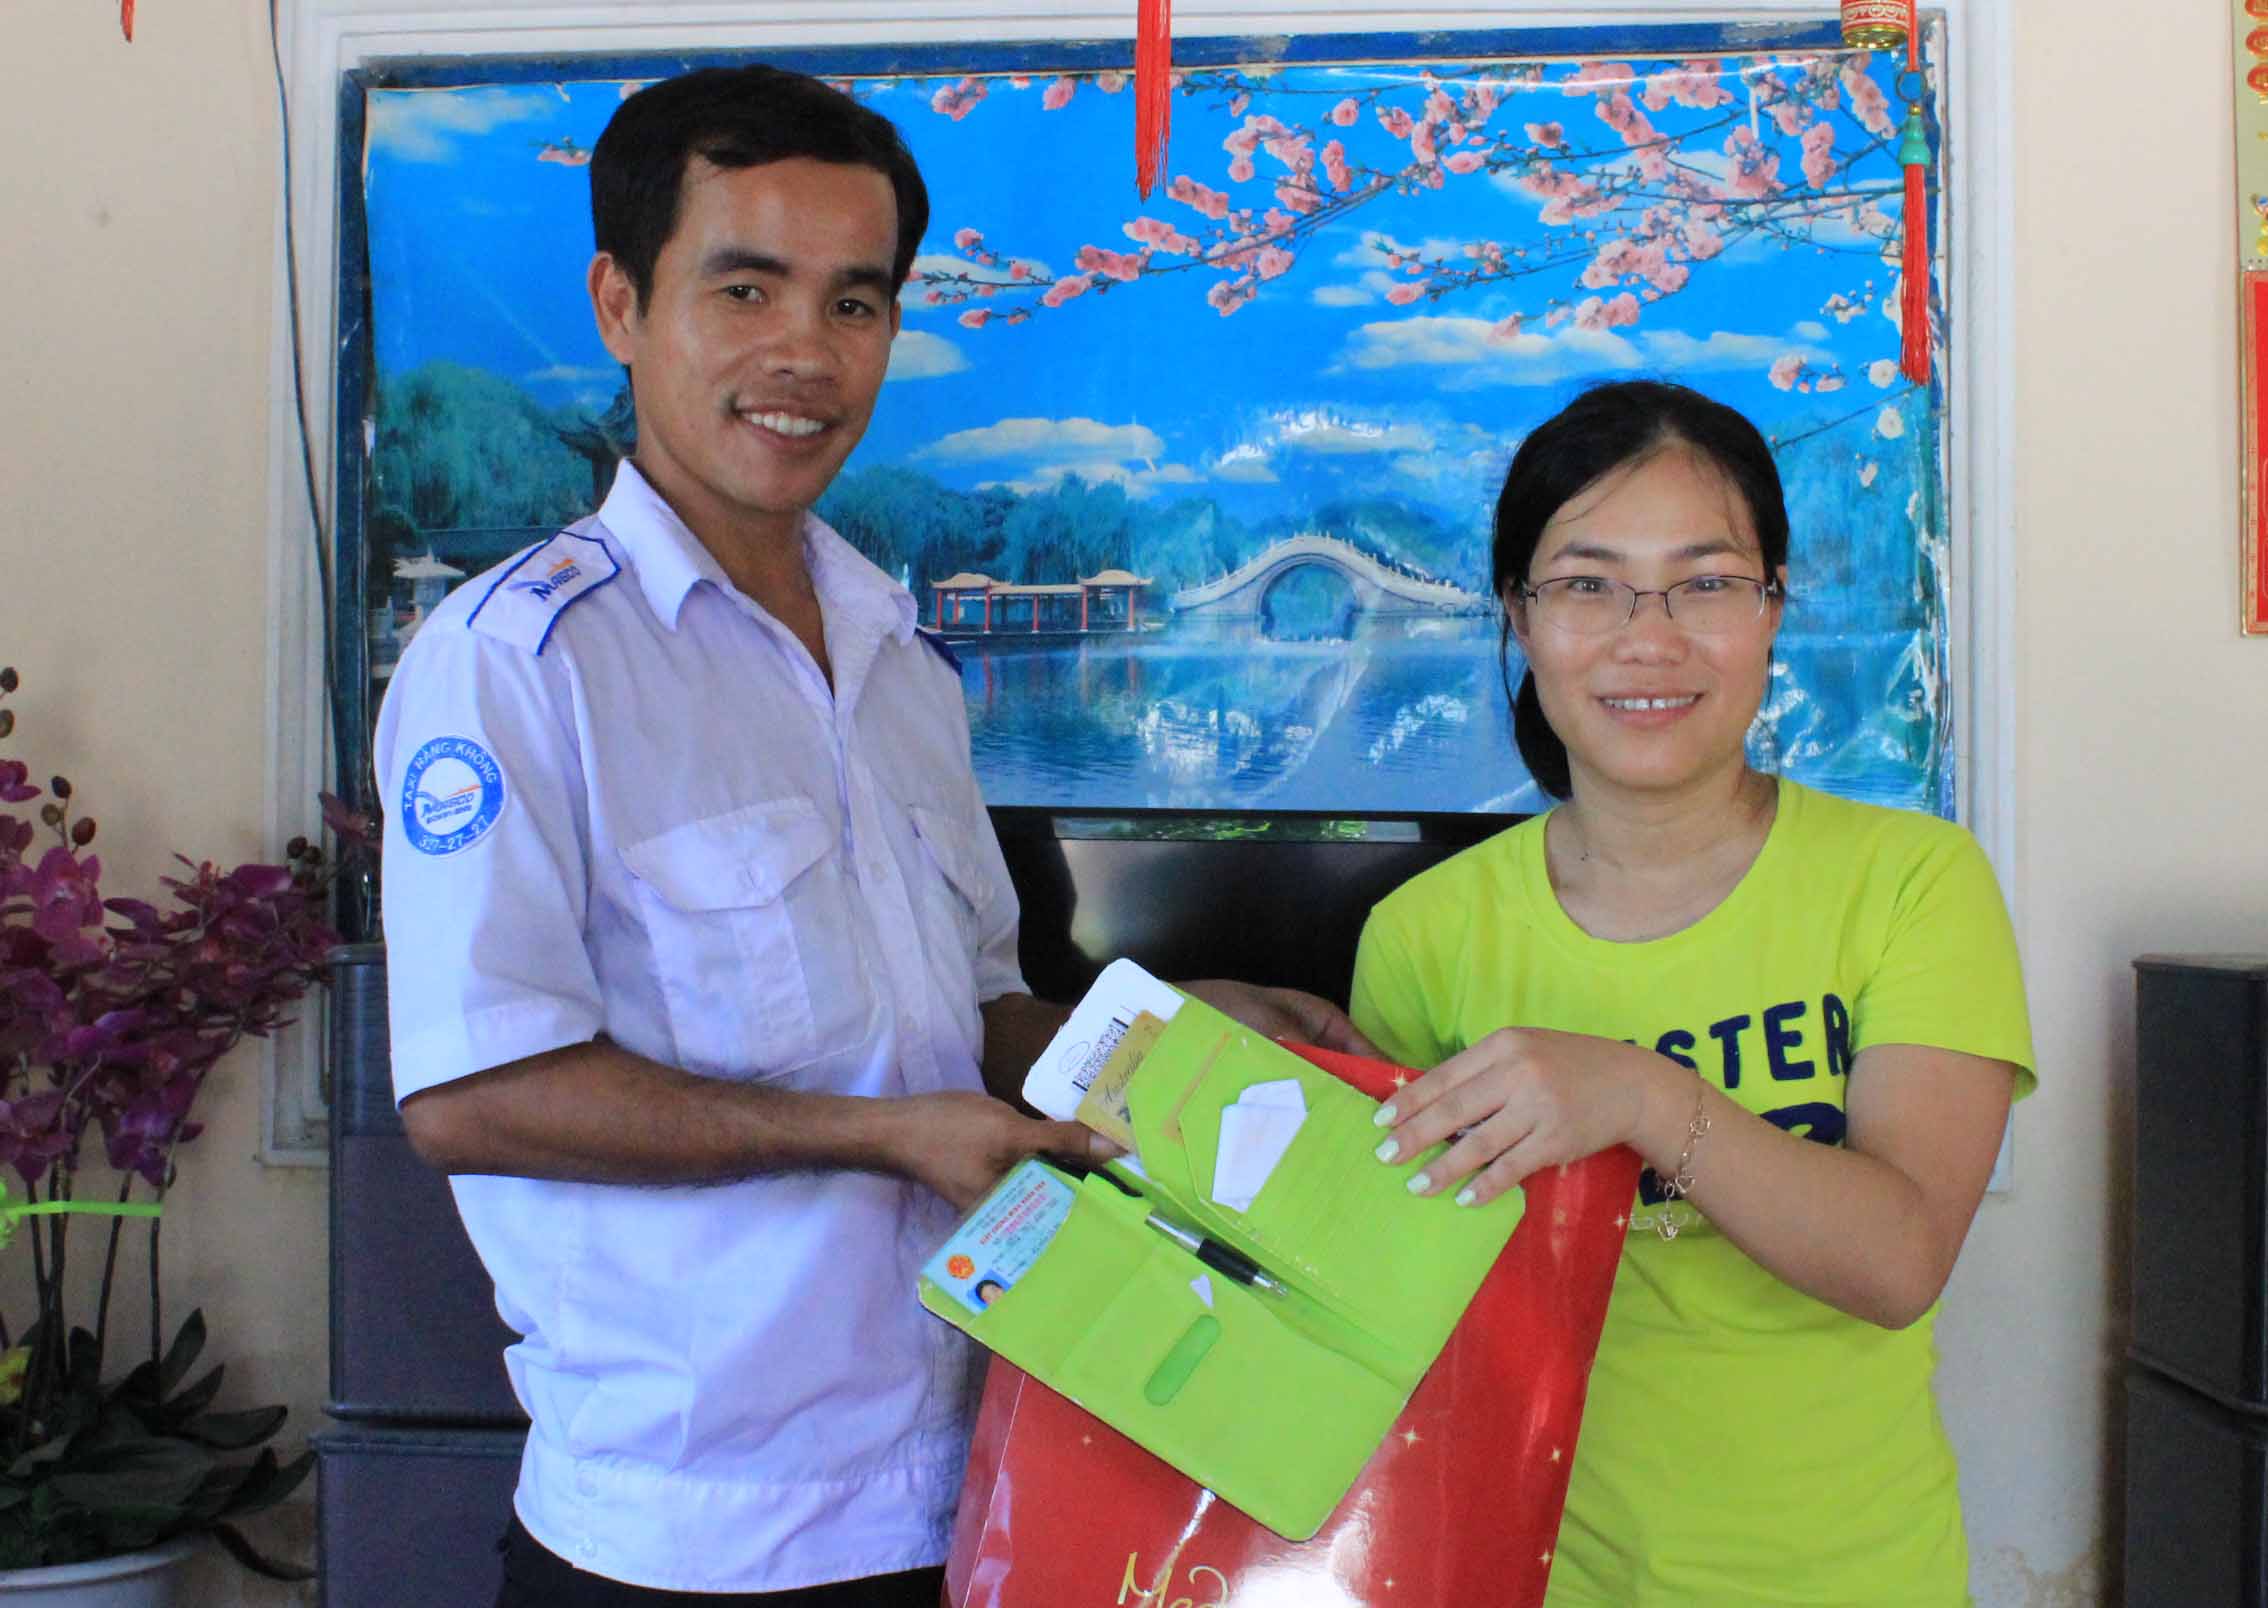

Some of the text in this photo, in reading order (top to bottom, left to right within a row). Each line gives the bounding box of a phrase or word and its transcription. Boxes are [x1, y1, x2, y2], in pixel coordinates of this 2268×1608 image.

[404, 774, 417, 810] TAXI
[455, 741, 497, 784] KHÔNG
[1621, 992, 1851, 1089] STER
